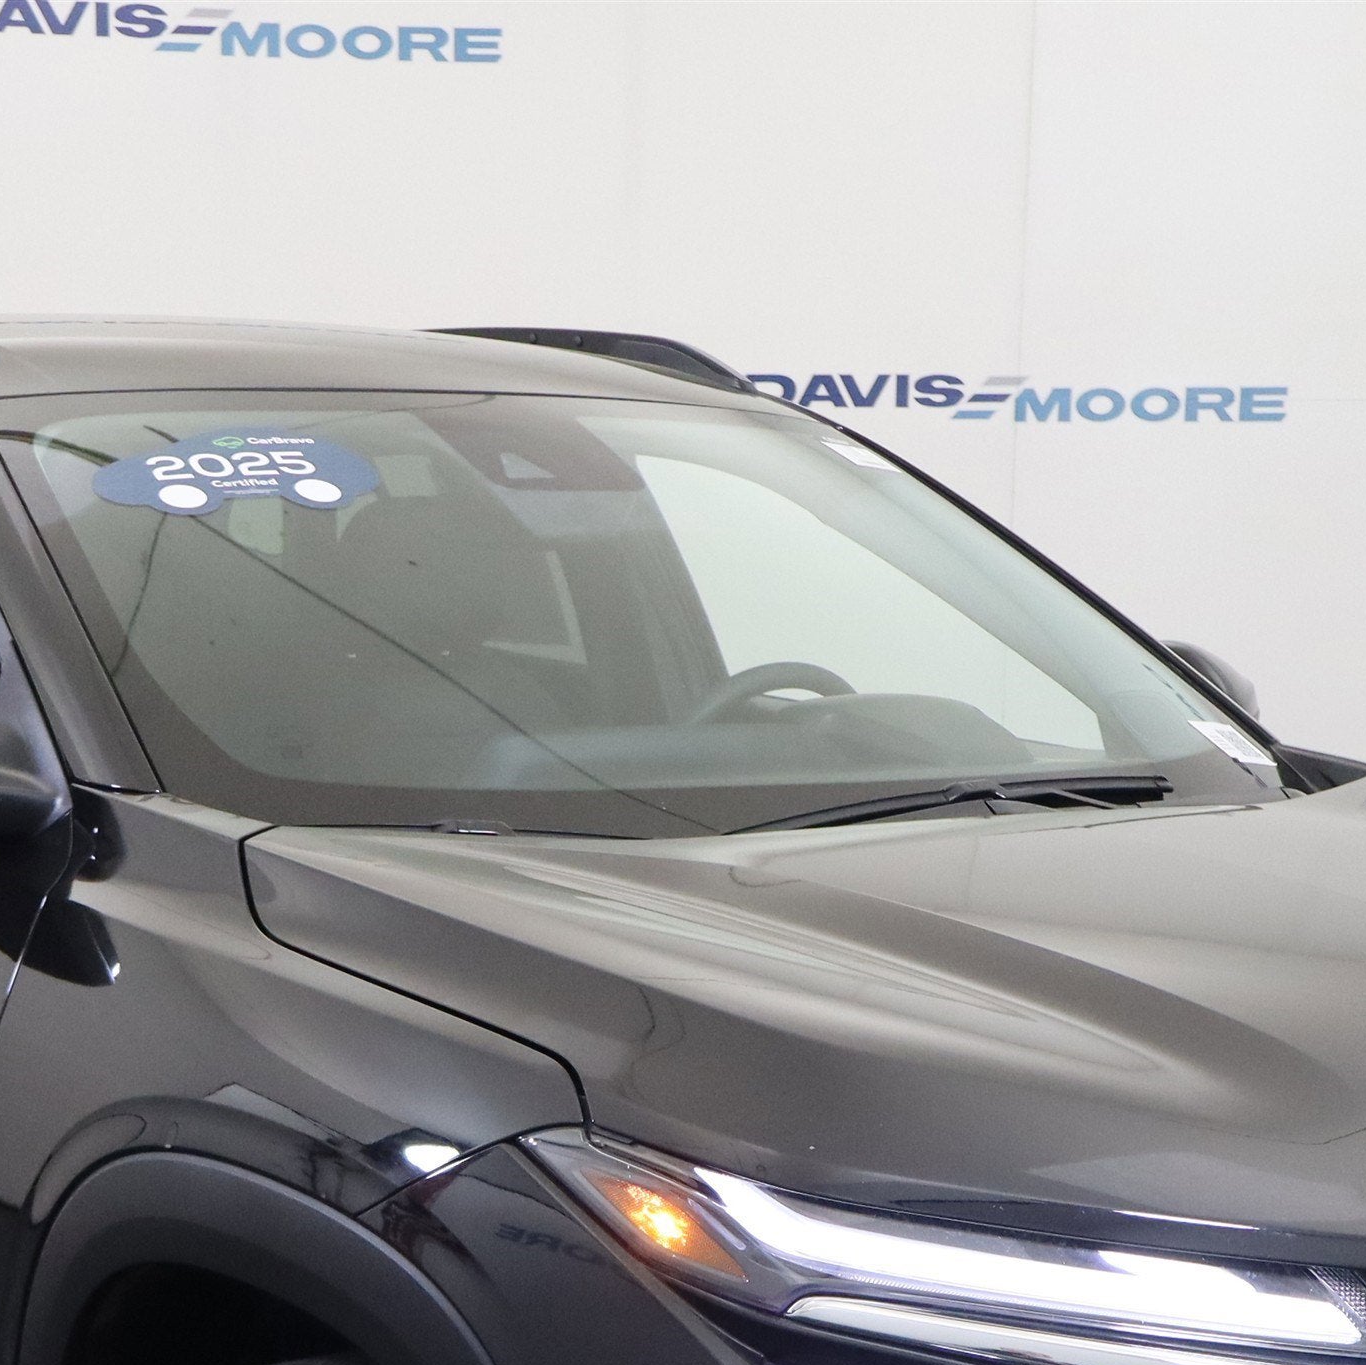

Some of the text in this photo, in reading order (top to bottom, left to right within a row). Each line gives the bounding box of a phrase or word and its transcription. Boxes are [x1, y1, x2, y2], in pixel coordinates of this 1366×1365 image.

[219, 21, 503, 64] MOORE
[746, 375, 1289, 422] DAVIS MOORE
[146, 451, 316, 481] 2025
[211, 478, 279, 488] Certified
